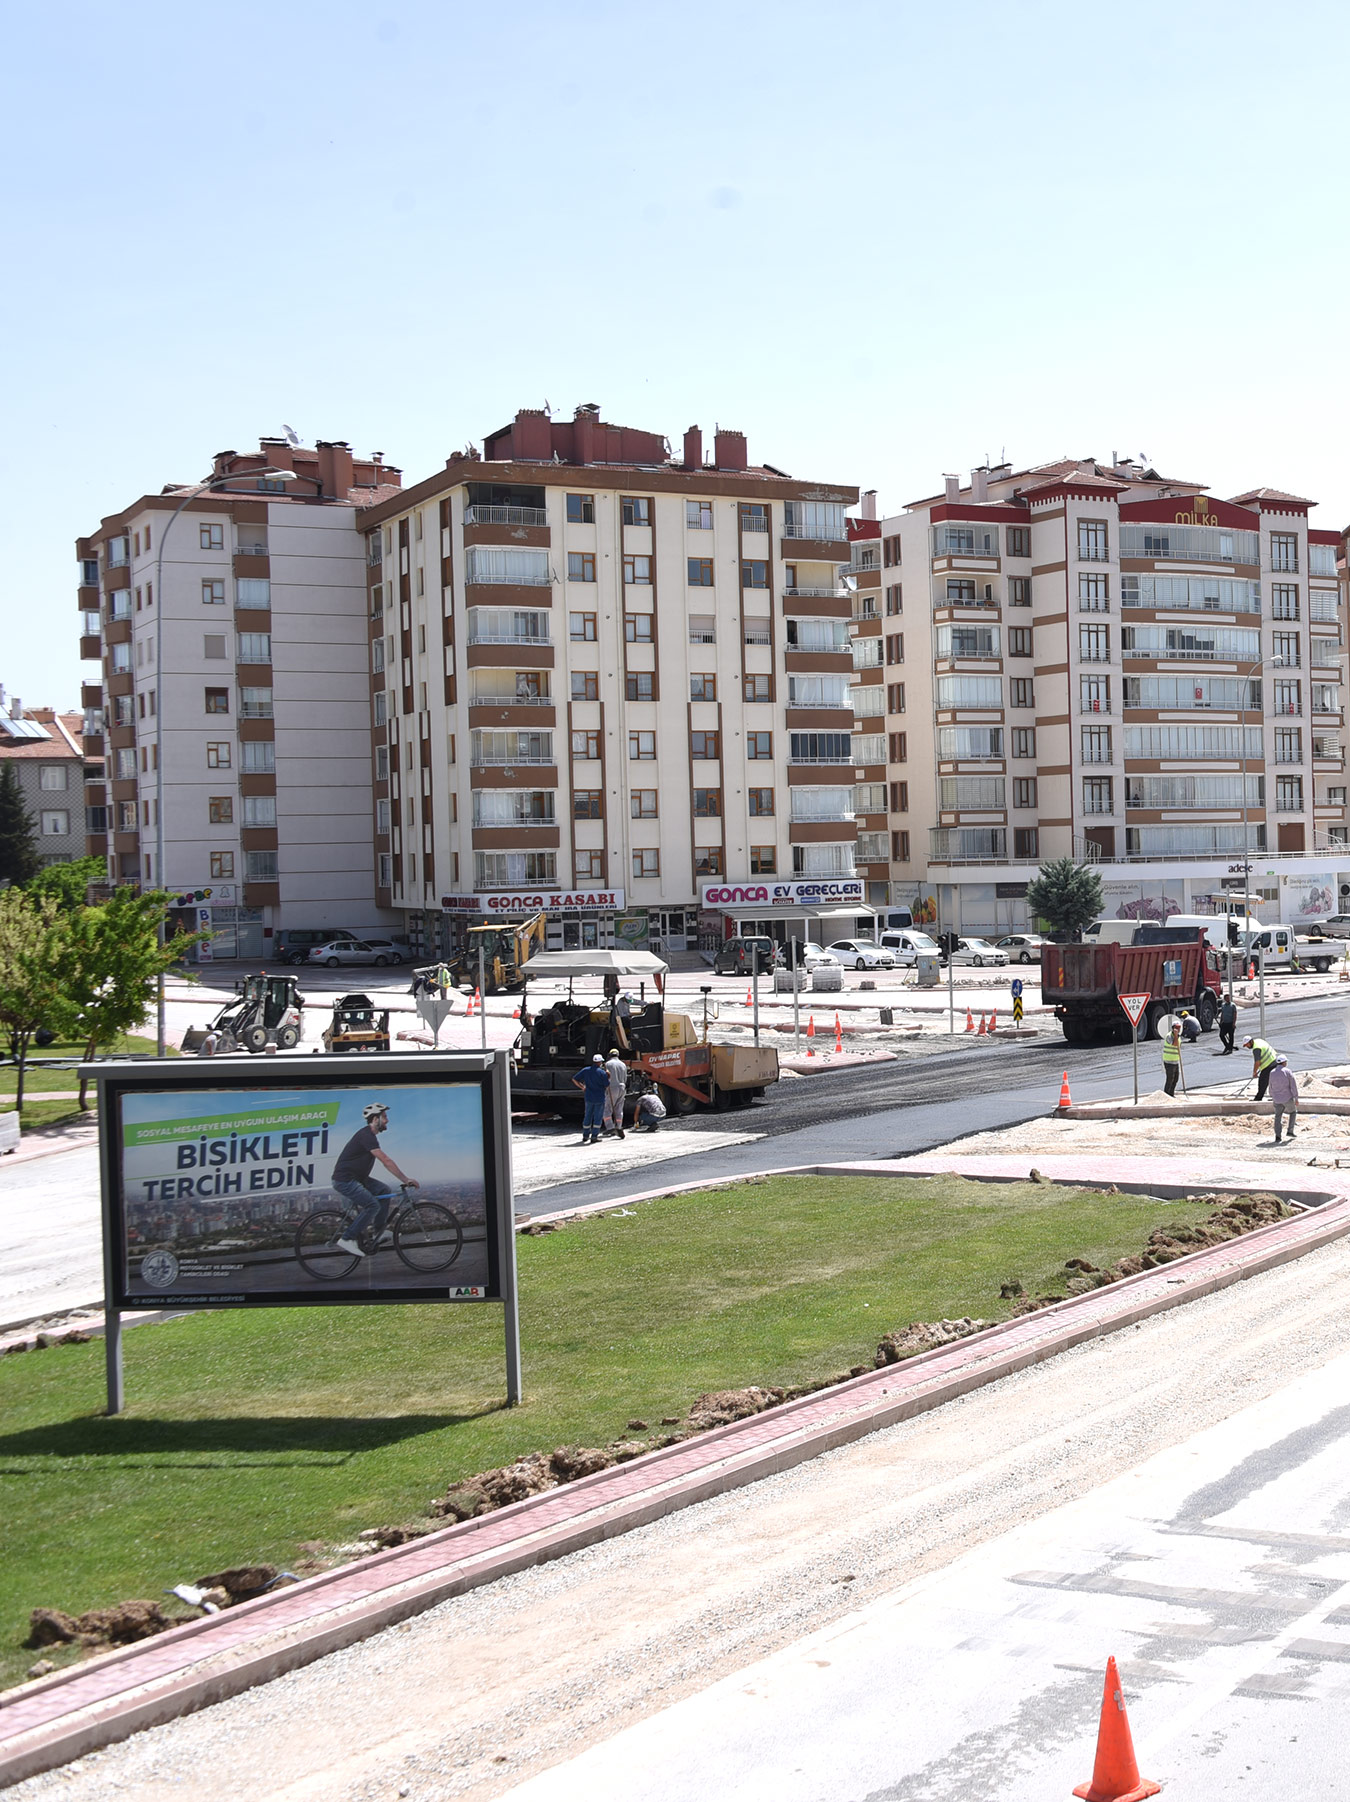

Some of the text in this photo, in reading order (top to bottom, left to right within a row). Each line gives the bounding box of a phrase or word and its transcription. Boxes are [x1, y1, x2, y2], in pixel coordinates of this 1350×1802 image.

[488, 893, 616, 908] GONCA KASABI
[706, 886, 768, 903] GONCA
[774, 886, 791, 896] EV
[649, 1052, 680, 1063] DYNAPAC
[136, 1111, 327, 1138] SOSYAL MESAFEYE EN UYGUN ULAŞIM ARACI
[177, 1122, 328, 1169] BİSİKLETİ
[143, 1159, 314, 1201] TERCİH EDİN
[456, 1288, 479, 1296] AAR
